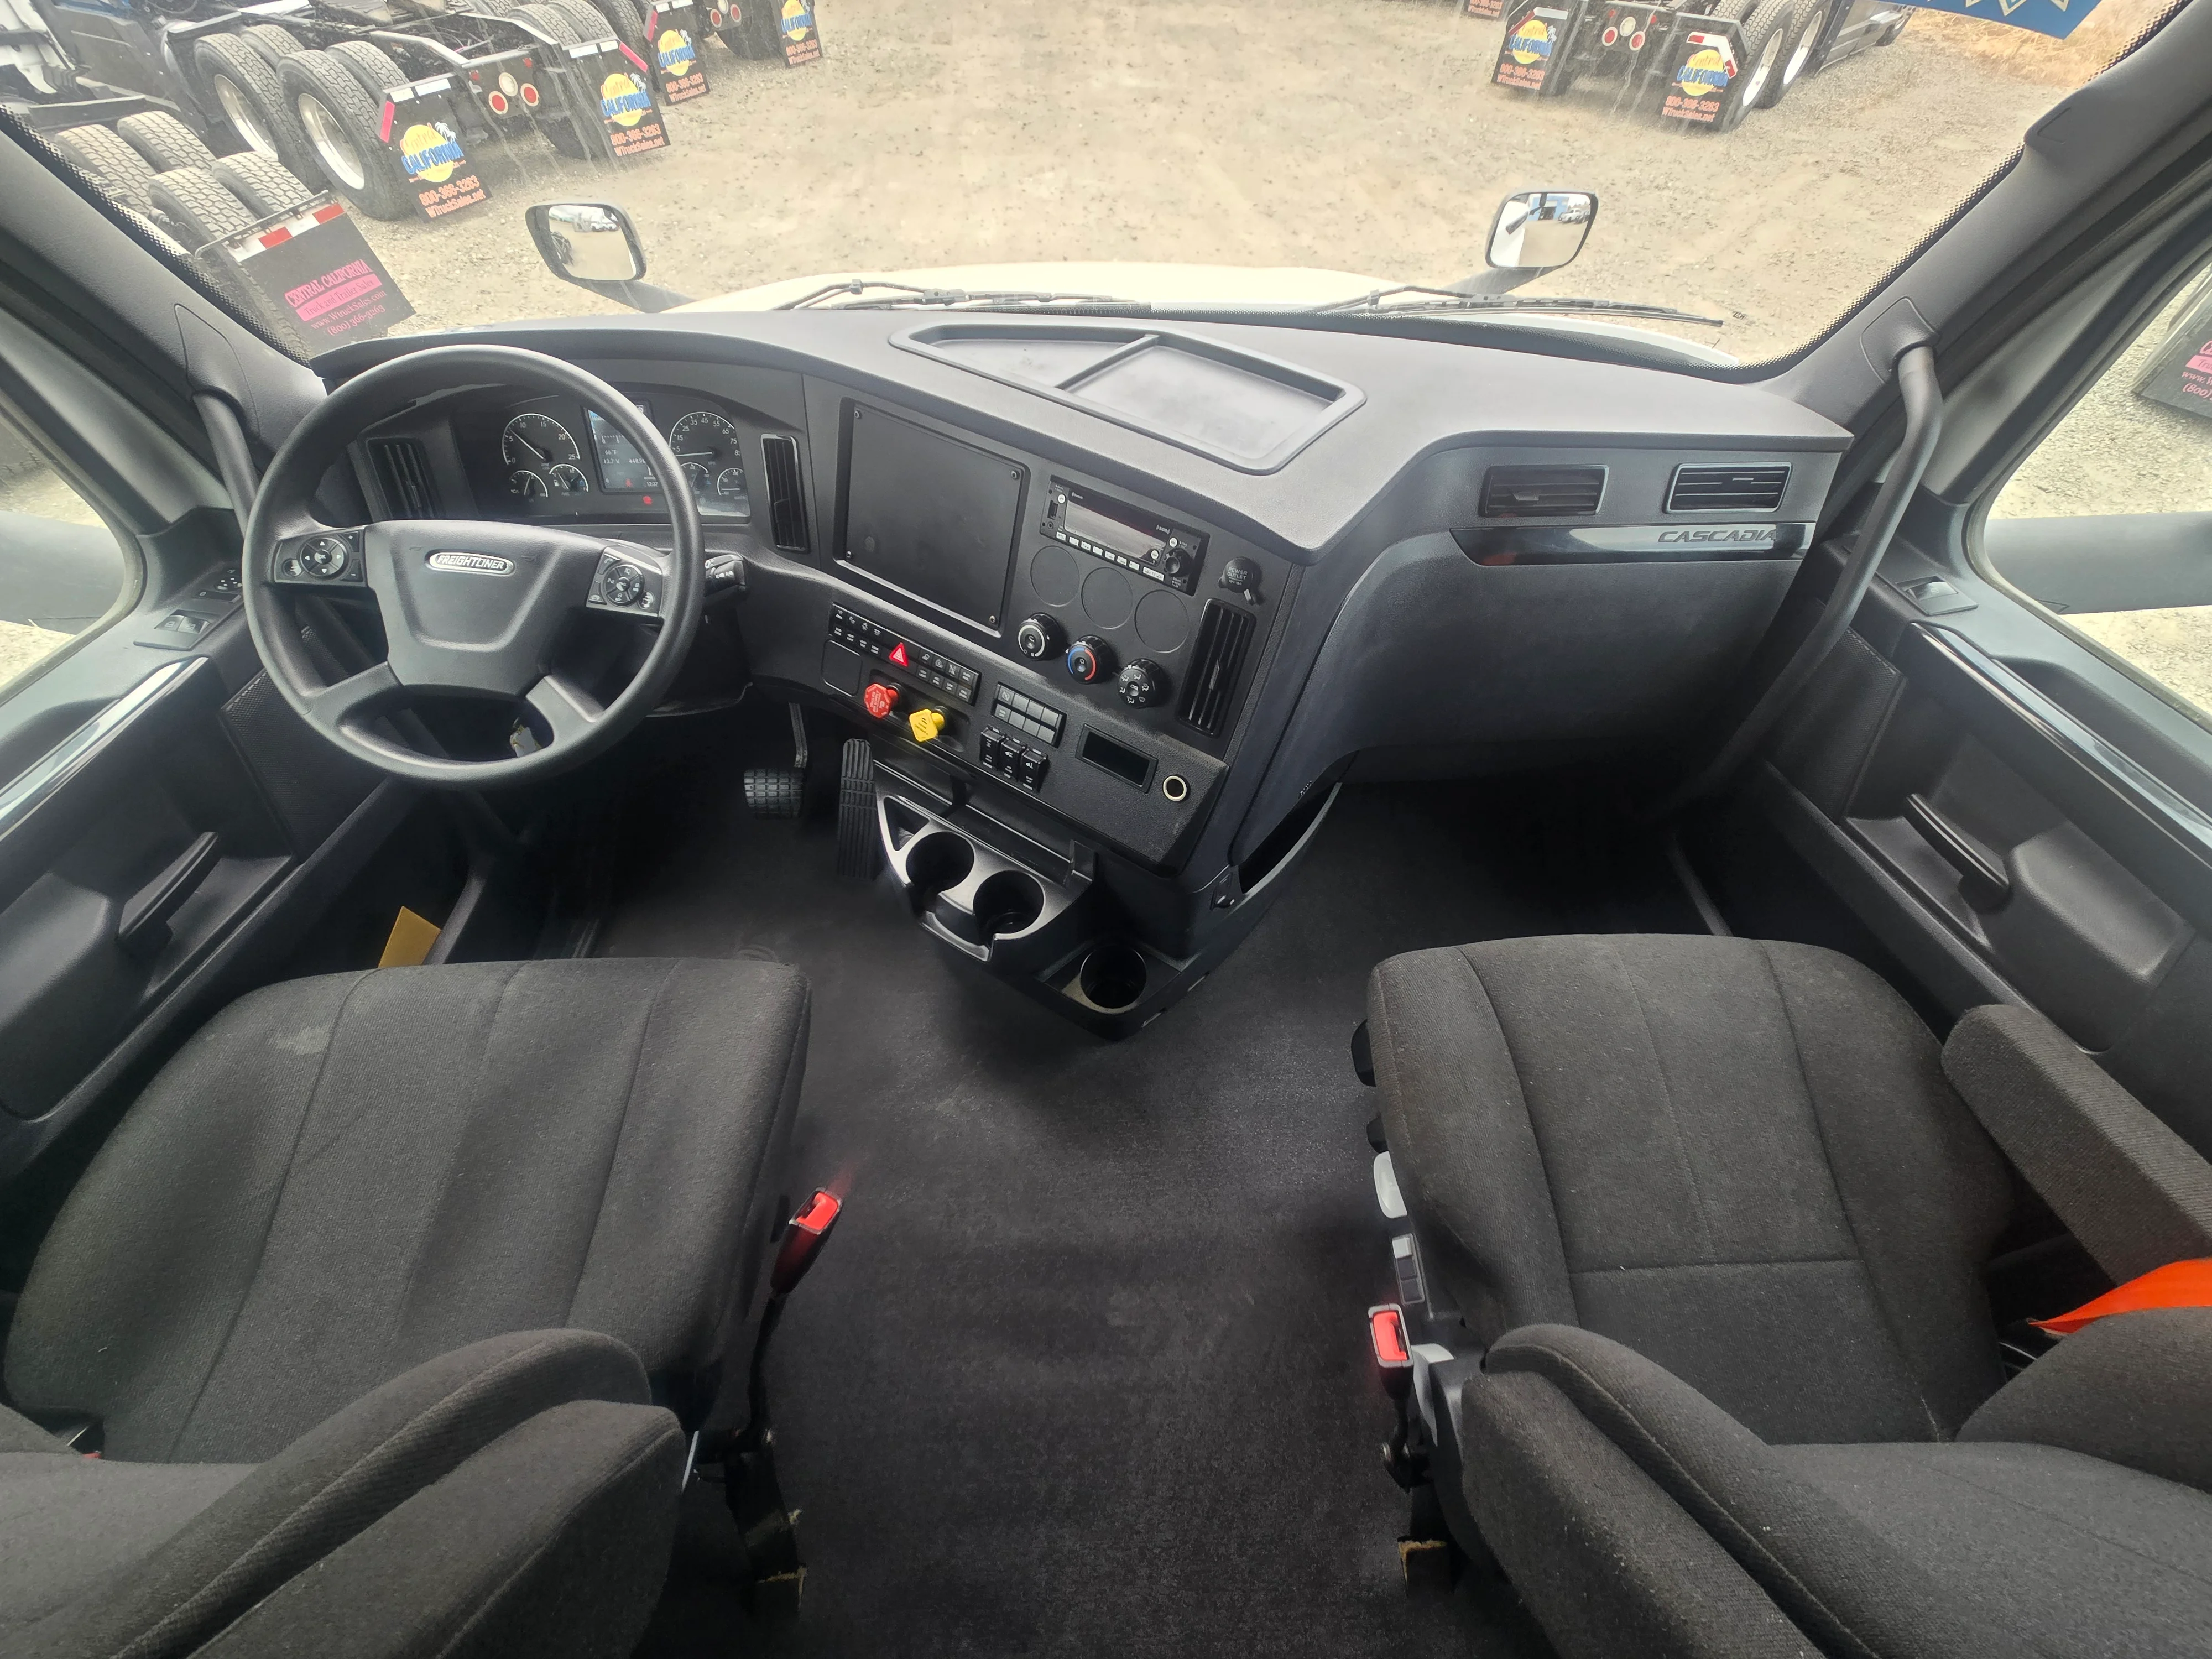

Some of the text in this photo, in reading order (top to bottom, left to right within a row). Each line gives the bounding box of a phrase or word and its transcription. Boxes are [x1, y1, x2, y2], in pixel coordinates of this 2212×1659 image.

[1677, 65, 1729, 87] CALIFORNIA
[600, 91, 651, 117] CALIFORNIA
[1662, 106, 1715, 122] WTruckSales.net
[1665, 95, 1720, 112] 800-366-3263
[610, 123, 661, 145] 800-366-3263
[401, 140, 464, 175] CALIFORNIA
[614, 136, 665, 157] WTruckSales.net
[419, 175, 480, 206] 800-366-3263
[425, 189, 486, 218] WTruckSales.net
[284, 258, 373, 307] CENTRAL CALIFORNIA
[304, 280, 374, 316] Truck and Trailer Sales
[327, 304, 386, 336] (800) 366-3263
[1658, 530, 1777, 542] CASCADIA
[437, 555, 505, 569] FREIGHTLINER
[1228, 566, 1248, 575] POWER
[1227, 571, 1246, 580] OUTLET
